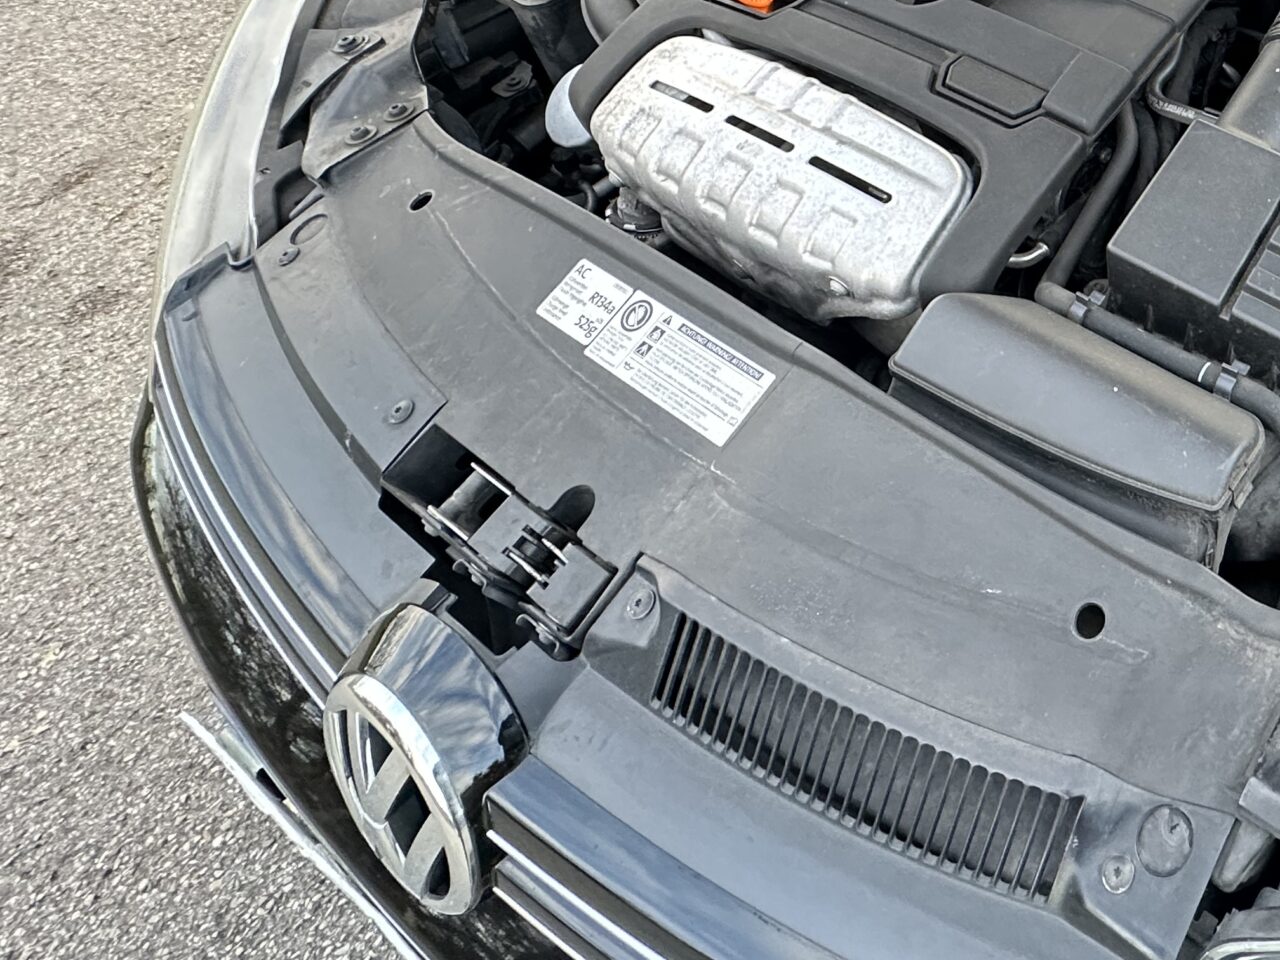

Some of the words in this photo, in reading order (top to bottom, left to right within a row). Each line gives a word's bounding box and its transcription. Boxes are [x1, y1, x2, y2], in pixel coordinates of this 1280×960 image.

[574, 264, 592, 279] AC
[588, 291, 616, 315] R134a
[574, 314, 598, 338] 525g
